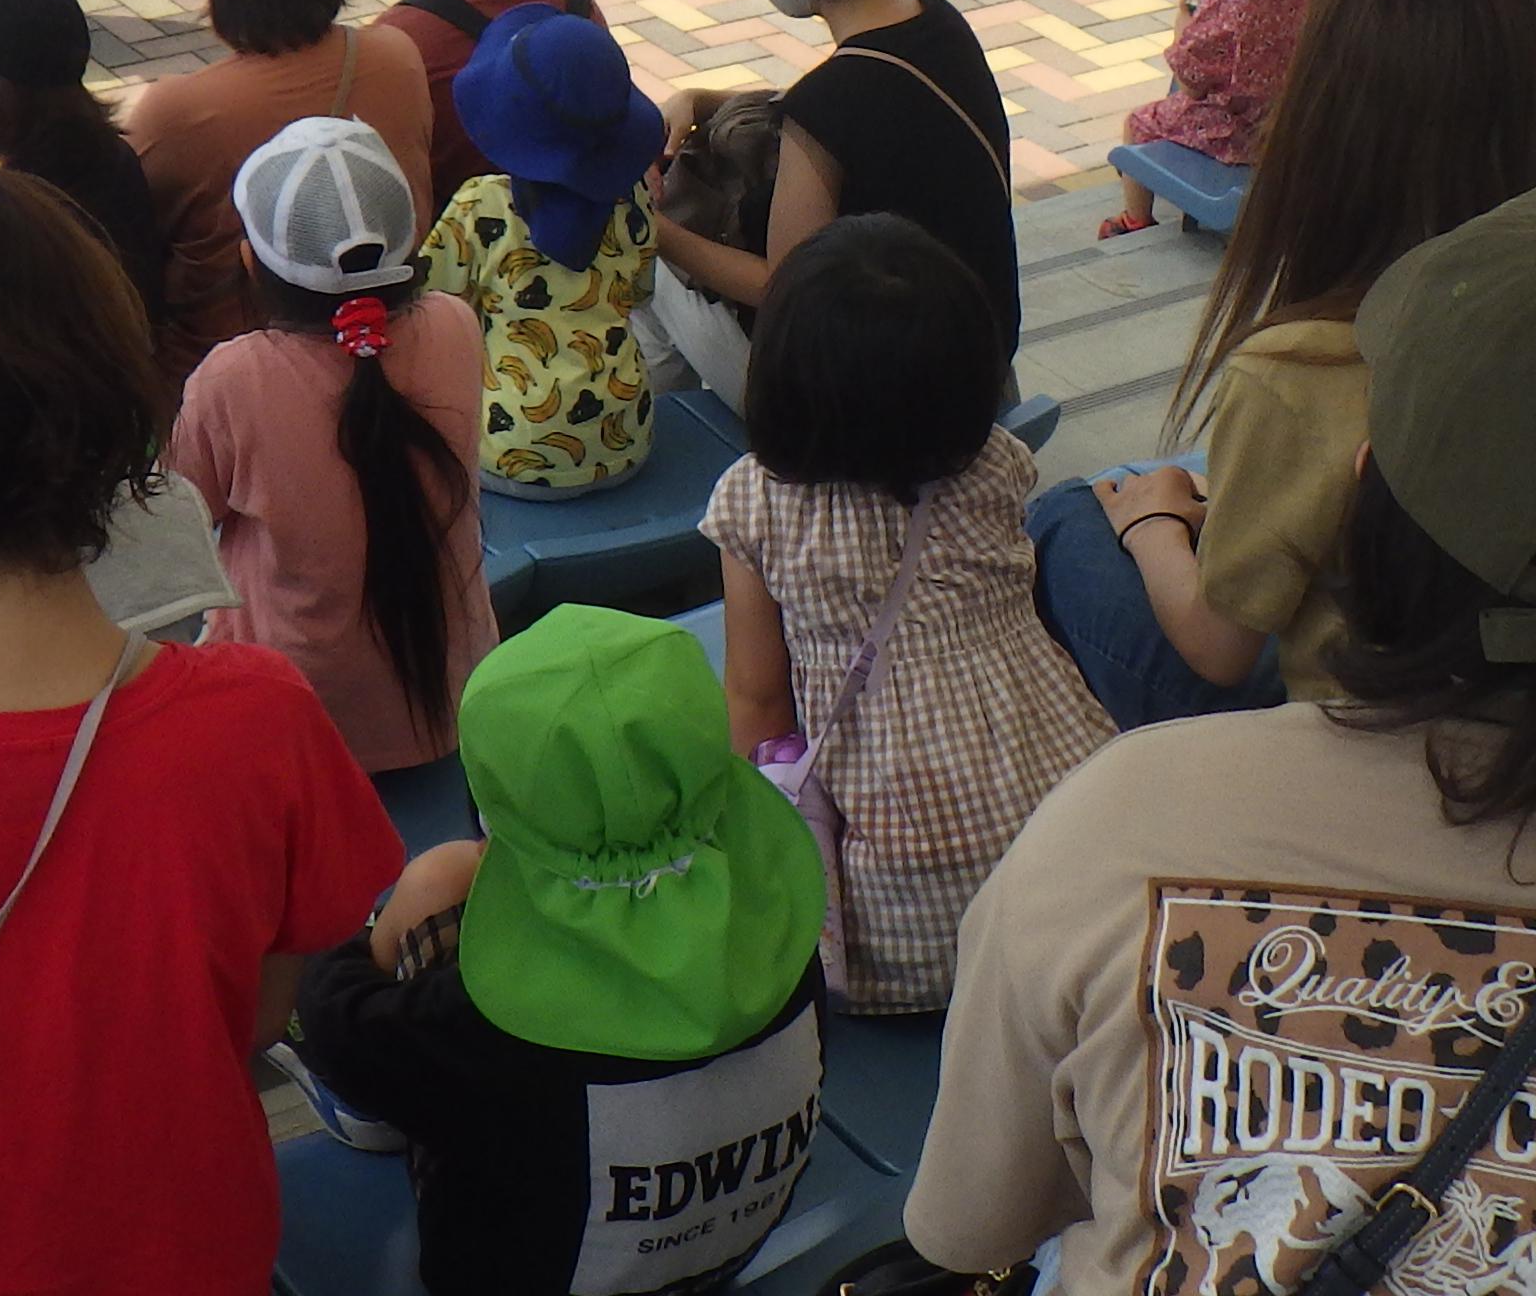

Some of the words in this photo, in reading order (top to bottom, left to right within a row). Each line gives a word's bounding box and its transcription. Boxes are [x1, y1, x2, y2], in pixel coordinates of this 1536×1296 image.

[1239, 925, 1475, 1036] Quality
[1183, 1020, 1435, 1155] RODEO
[605, 1093, 815, 1222] EDWIN
[636, 1216, 716, 1254] SINCE
